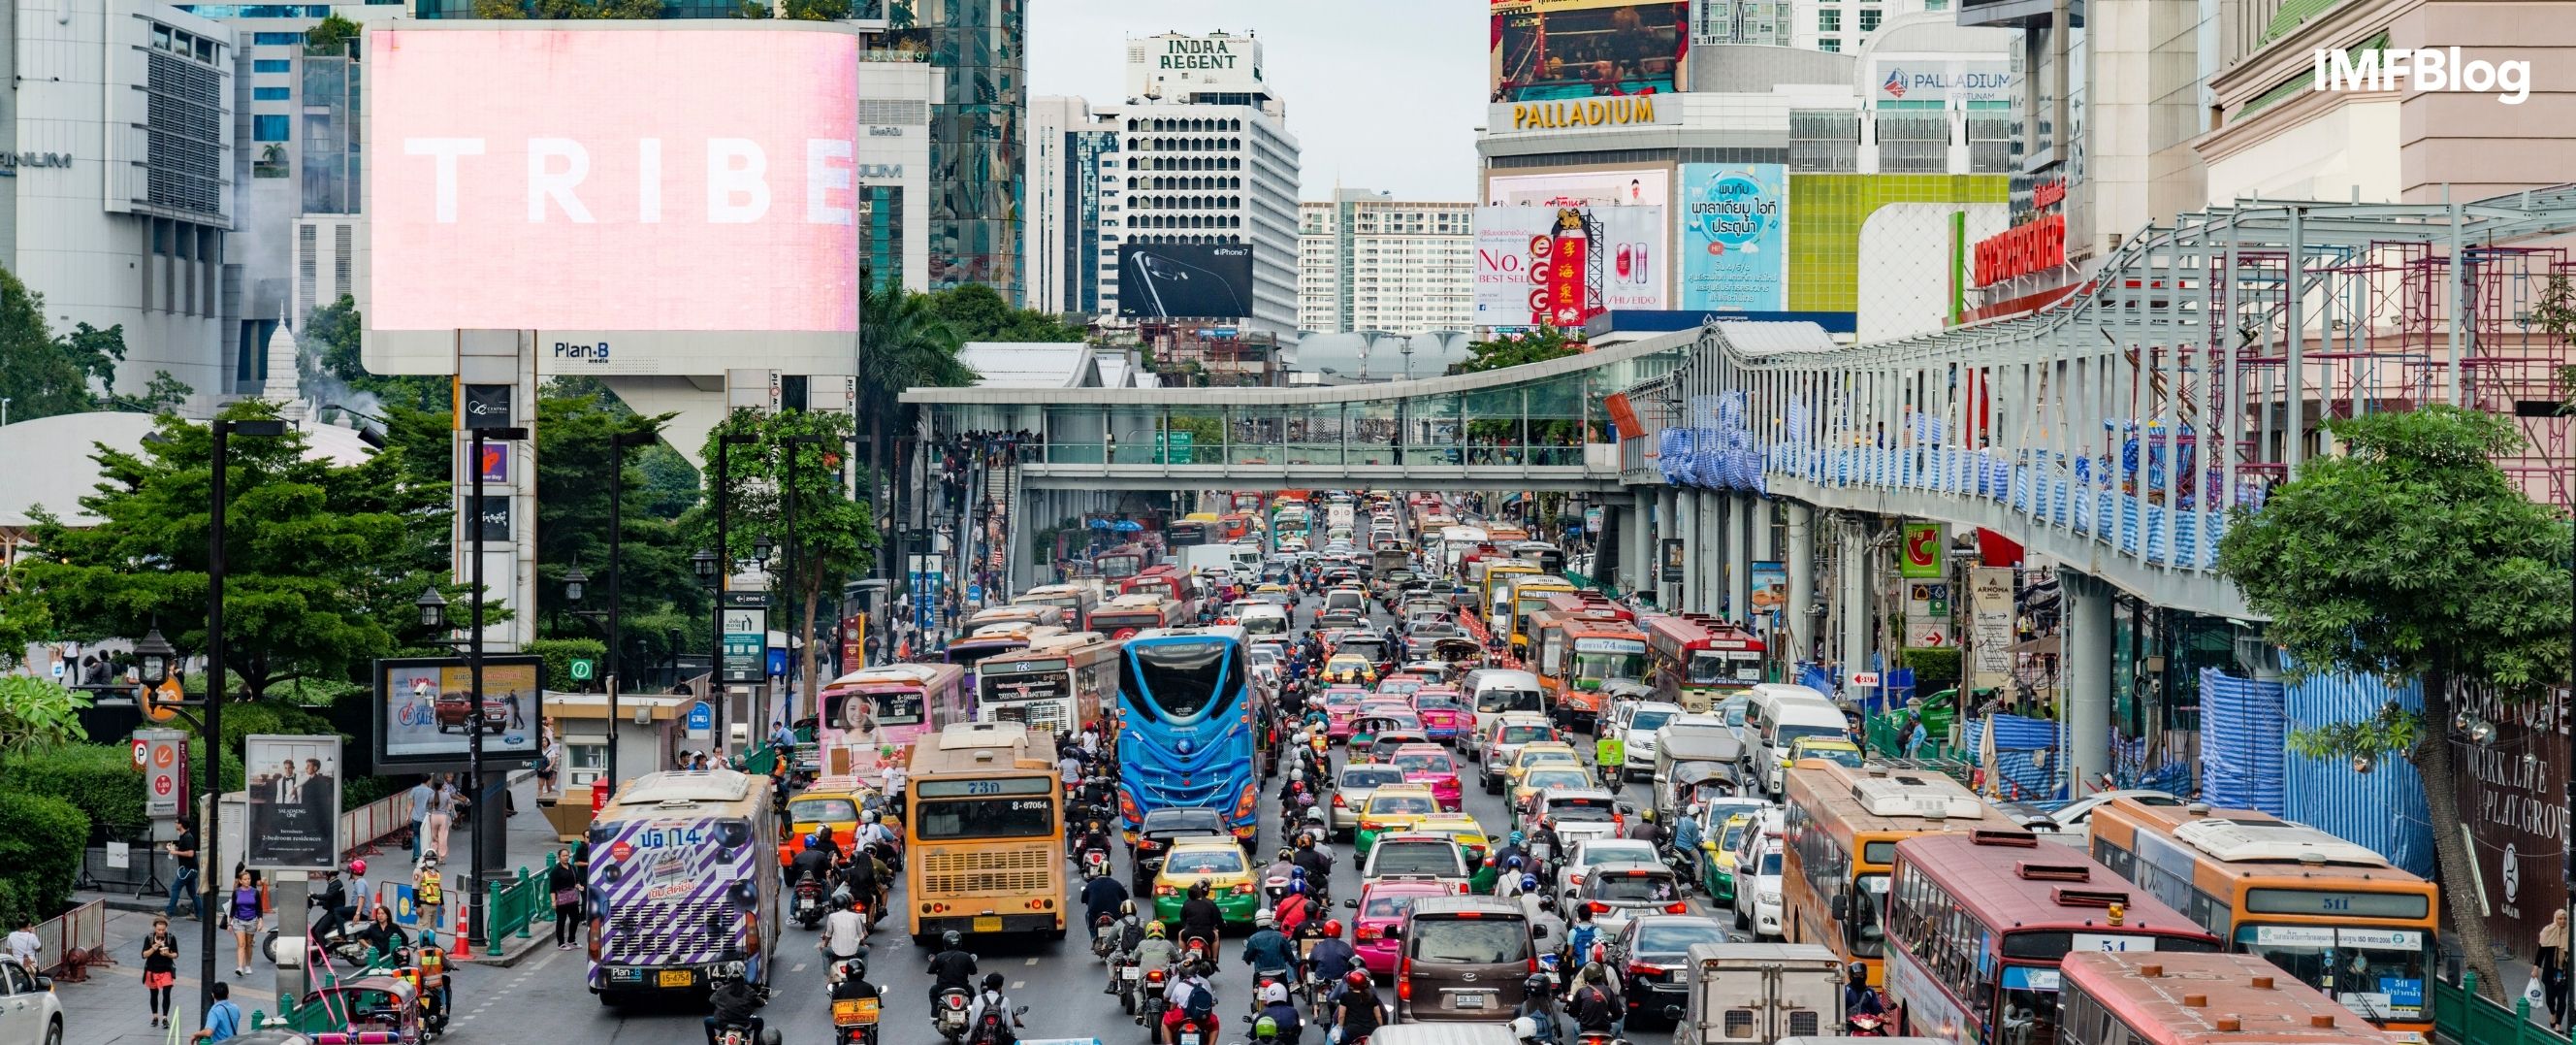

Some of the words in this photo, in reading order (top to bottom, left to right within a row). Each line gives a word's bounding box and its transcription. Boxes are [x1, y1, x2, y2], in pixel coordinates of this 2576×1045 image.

[1169, 40, 1229, 54] INDRA
[1160, 54, 1238, 69] REGENT
[1914, 72, 2011, 89] PALLADIUM
[1513, 96, 1655, 129] PALLADIUM
[403, 137, 853, 226] TRIBE
[1719, 182, 1750, 195] พบกับ
[1479, 248, 1525, 272] No.
[1479, 275, 1502, 283] BEST
[1907, 530, 1925, 540] Big
[1602, 640, 1617, 650] 74
[416, 711, 434, 726] SALE
[138, 747, 145, 762] P
[968, 781, 1001, 794] 73ก
[1012, 800, 1047, 811] 8-67054
[678, 829, 701, 846] 14
[2323, 898, 2350, 911] 511
[2395, 979, 2409, 988] 511
